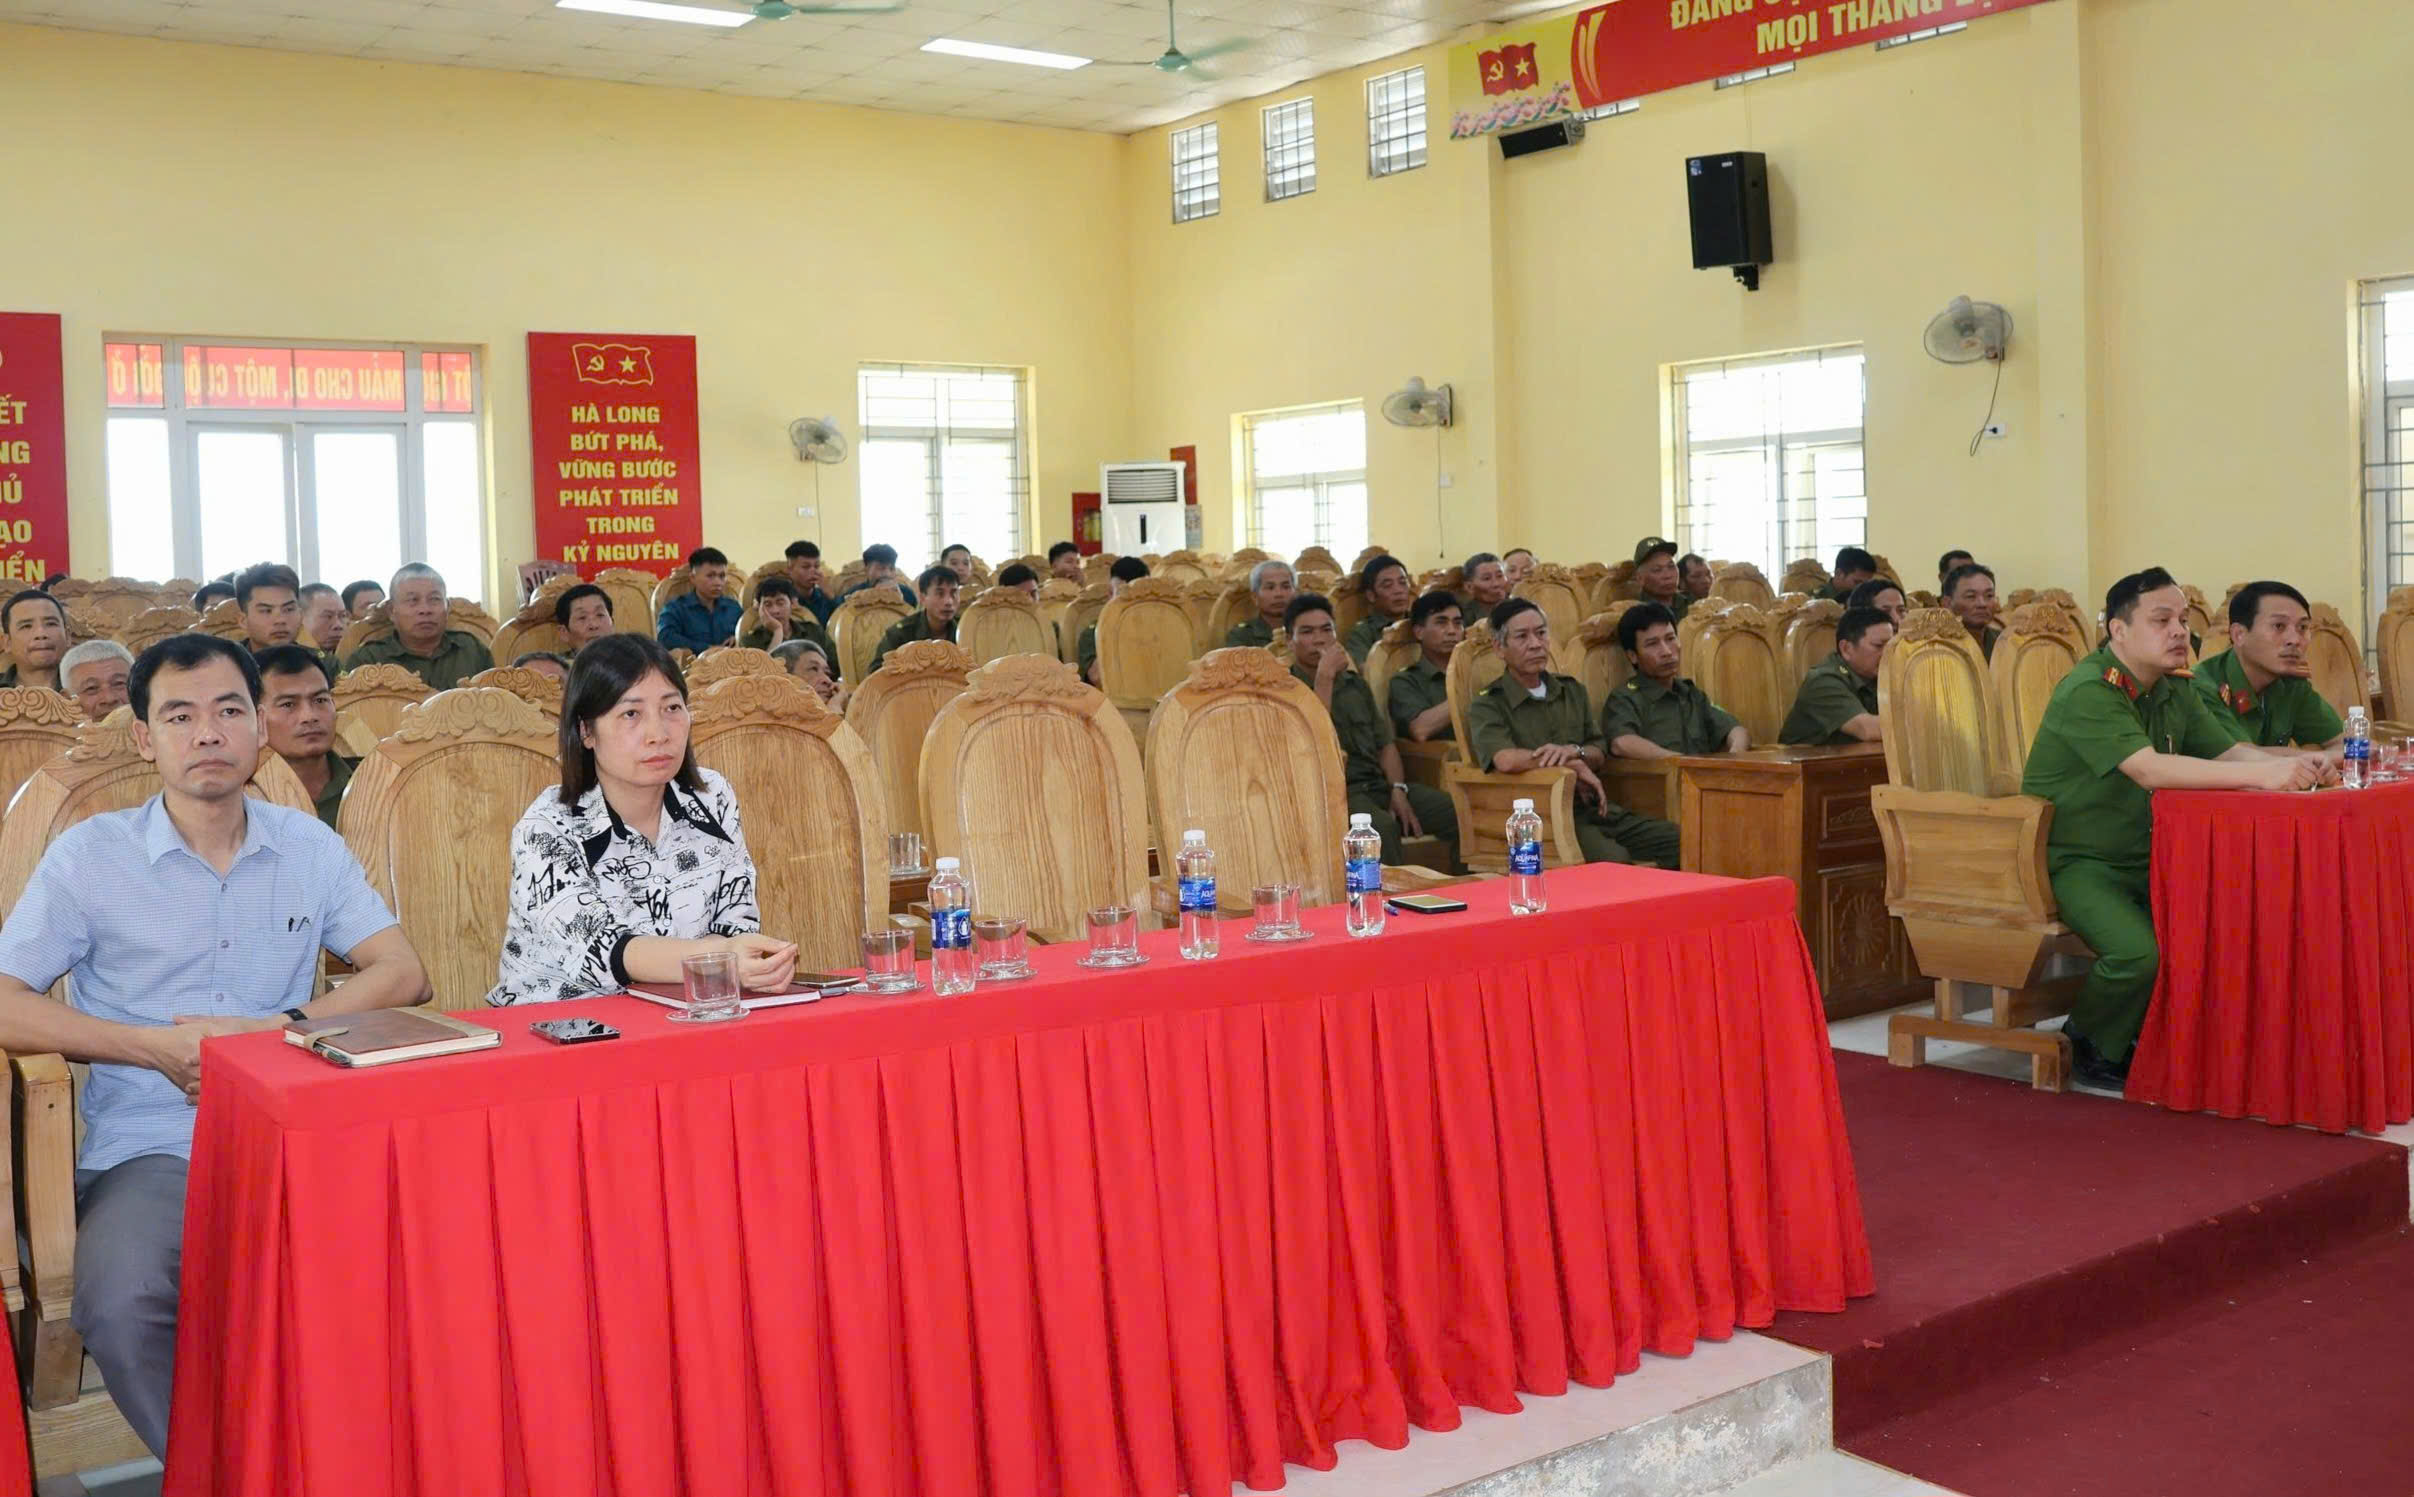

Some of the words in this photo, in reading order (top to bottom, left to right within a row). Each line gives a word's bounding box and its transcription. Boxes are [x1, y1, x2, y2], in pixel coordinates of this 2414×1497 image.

[1757, 11, 1818, 54] MỌI
[571, 403, 600, 423] HÀ
[606, 406, 660, 423] LONG
[570, 430, 610, 451] BỨT
[616, 430, 664, 452] PHÁ,
[559, 458, 615, 479] VỮNG
[621, 458, 677, 479] BƯỚC
[559, 486, 613, 507] PHÁT
[619, 481, 678, 506] TRIỂN
[586, 516, 655, 534] TRONG
[563, 540, 590, 563] KỶ
[597, 540, 679, 562] NGUYÊN
